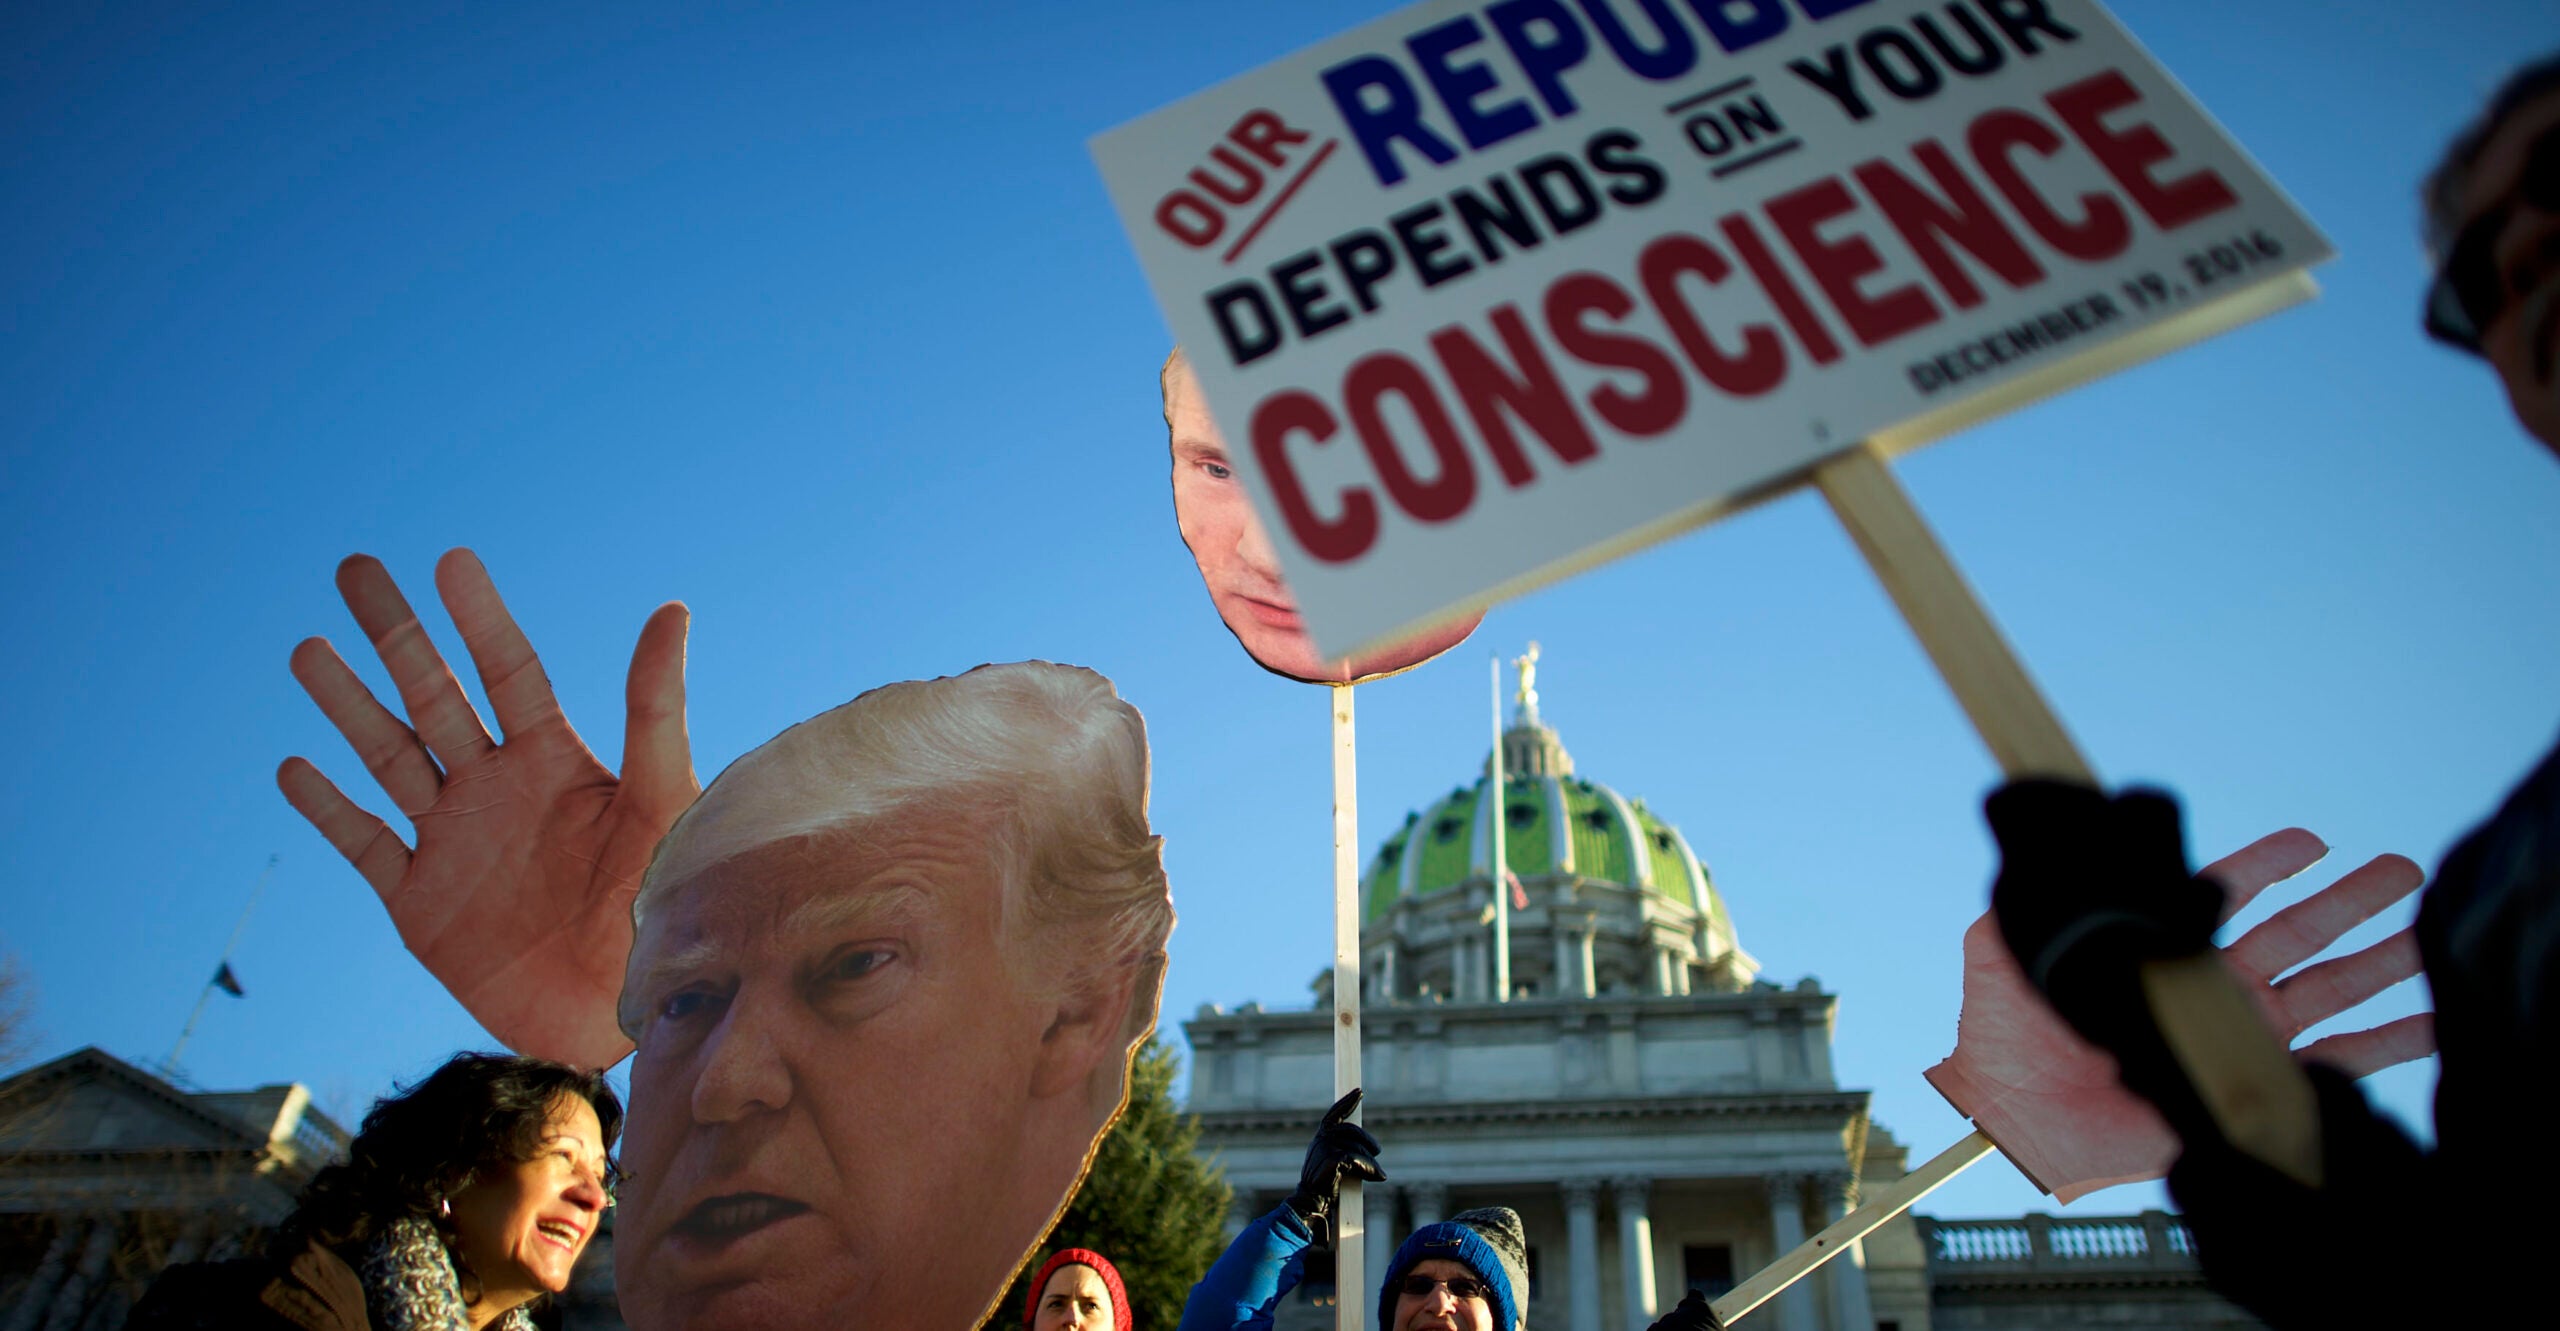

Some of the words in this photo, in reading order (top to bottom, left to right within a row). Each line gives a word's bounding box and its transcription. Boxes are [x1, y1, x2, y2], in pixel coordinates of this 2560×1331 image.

[1153, 108, 1311, 250] OUR
[1318, 0, 1882, 188] REPU
[1204, 129, 1668, 366] DEPENDS
[1683, 94, 1785, 158] ON
[1786, 0, 2081, 122] YOUR
[1249, 69, 2240, 567] CONSCIENCE
[1907, 292, 2124, 395] DECEMBER
[2121, 270, 2189, 312] 19,
[2184, 228, 2283, 288] 2016
